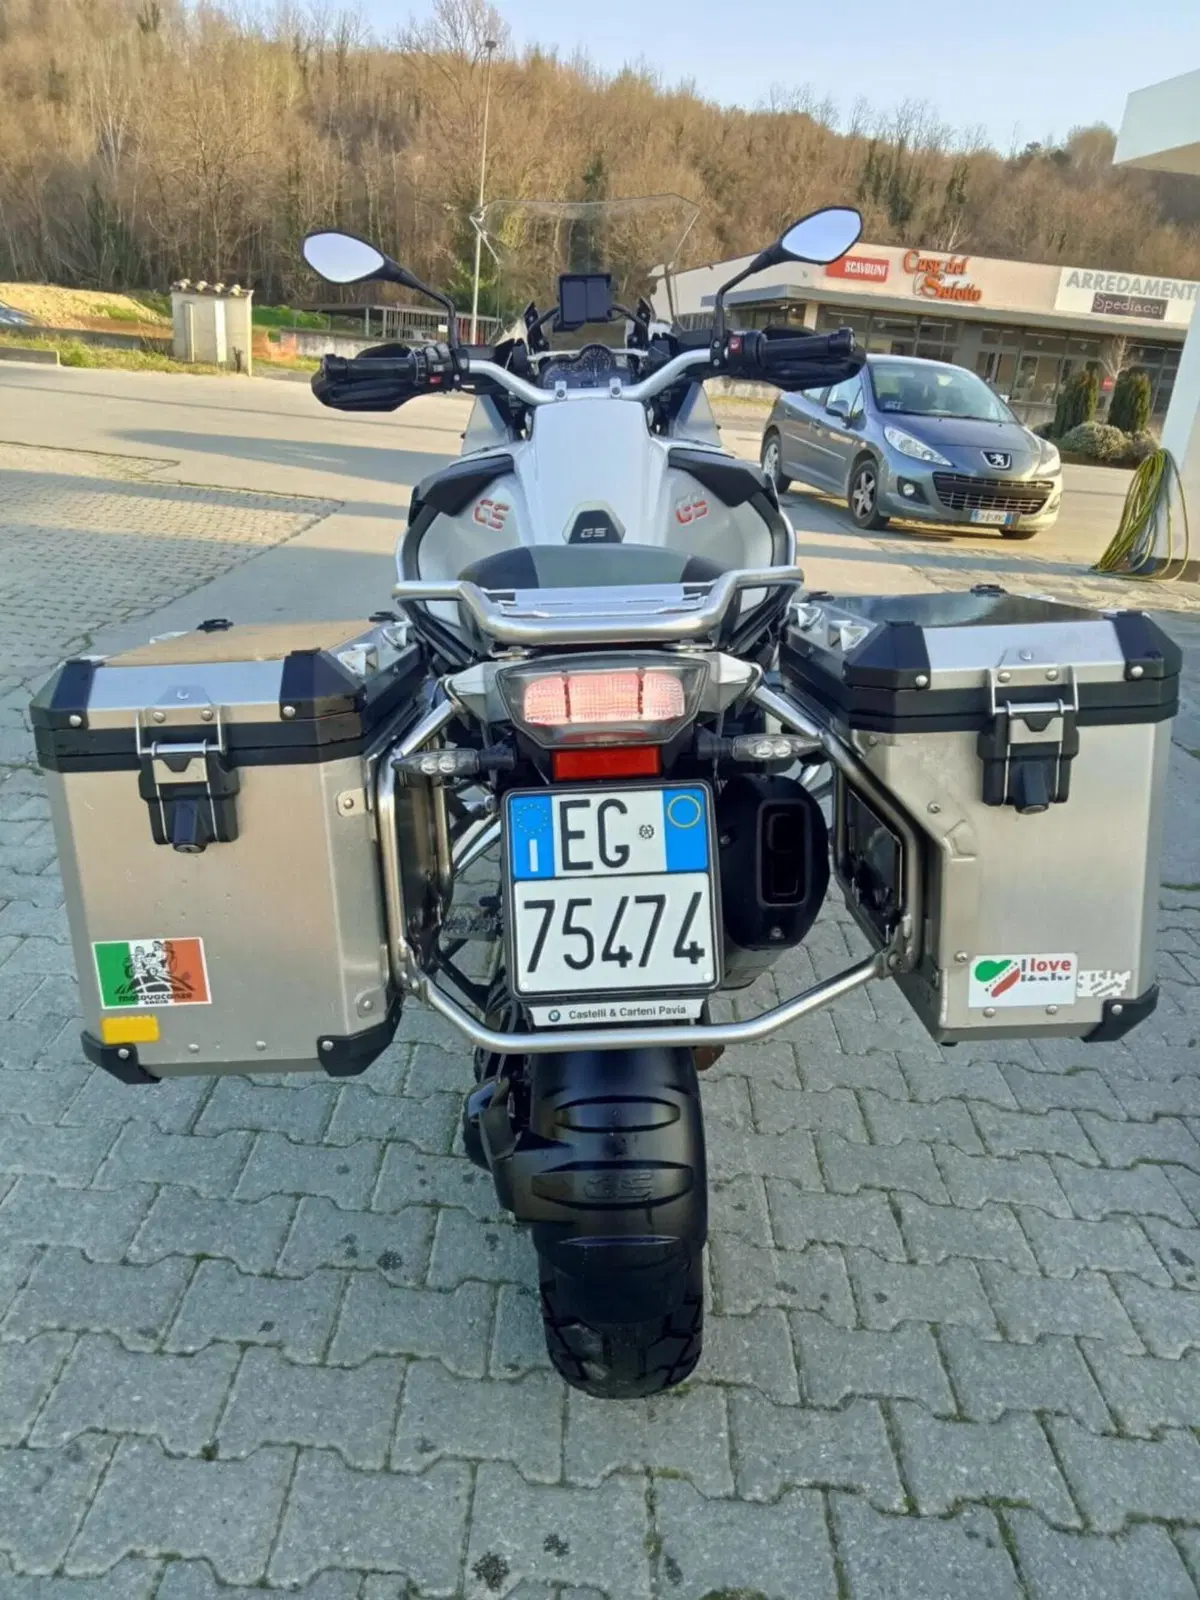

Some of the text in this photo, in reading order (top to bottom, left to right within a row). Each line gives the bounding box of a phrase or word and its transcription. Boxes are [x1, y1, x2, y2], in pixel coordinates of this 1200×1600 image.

[843, 260, 887, 277] SCAVOLINI
[1094, 293, 1163, 315] Spediacci
[580, 527, 608, 539] GS
[559, 798, 631, 871] EG
[523, 891, 705, 973] 75474
[1030, 957, 1072, 973] love
[568, 1008, 607, 1020] Castelli
[609, 1008, 617, 1018] &
[658, 1004, 687, 1016] Pavia
